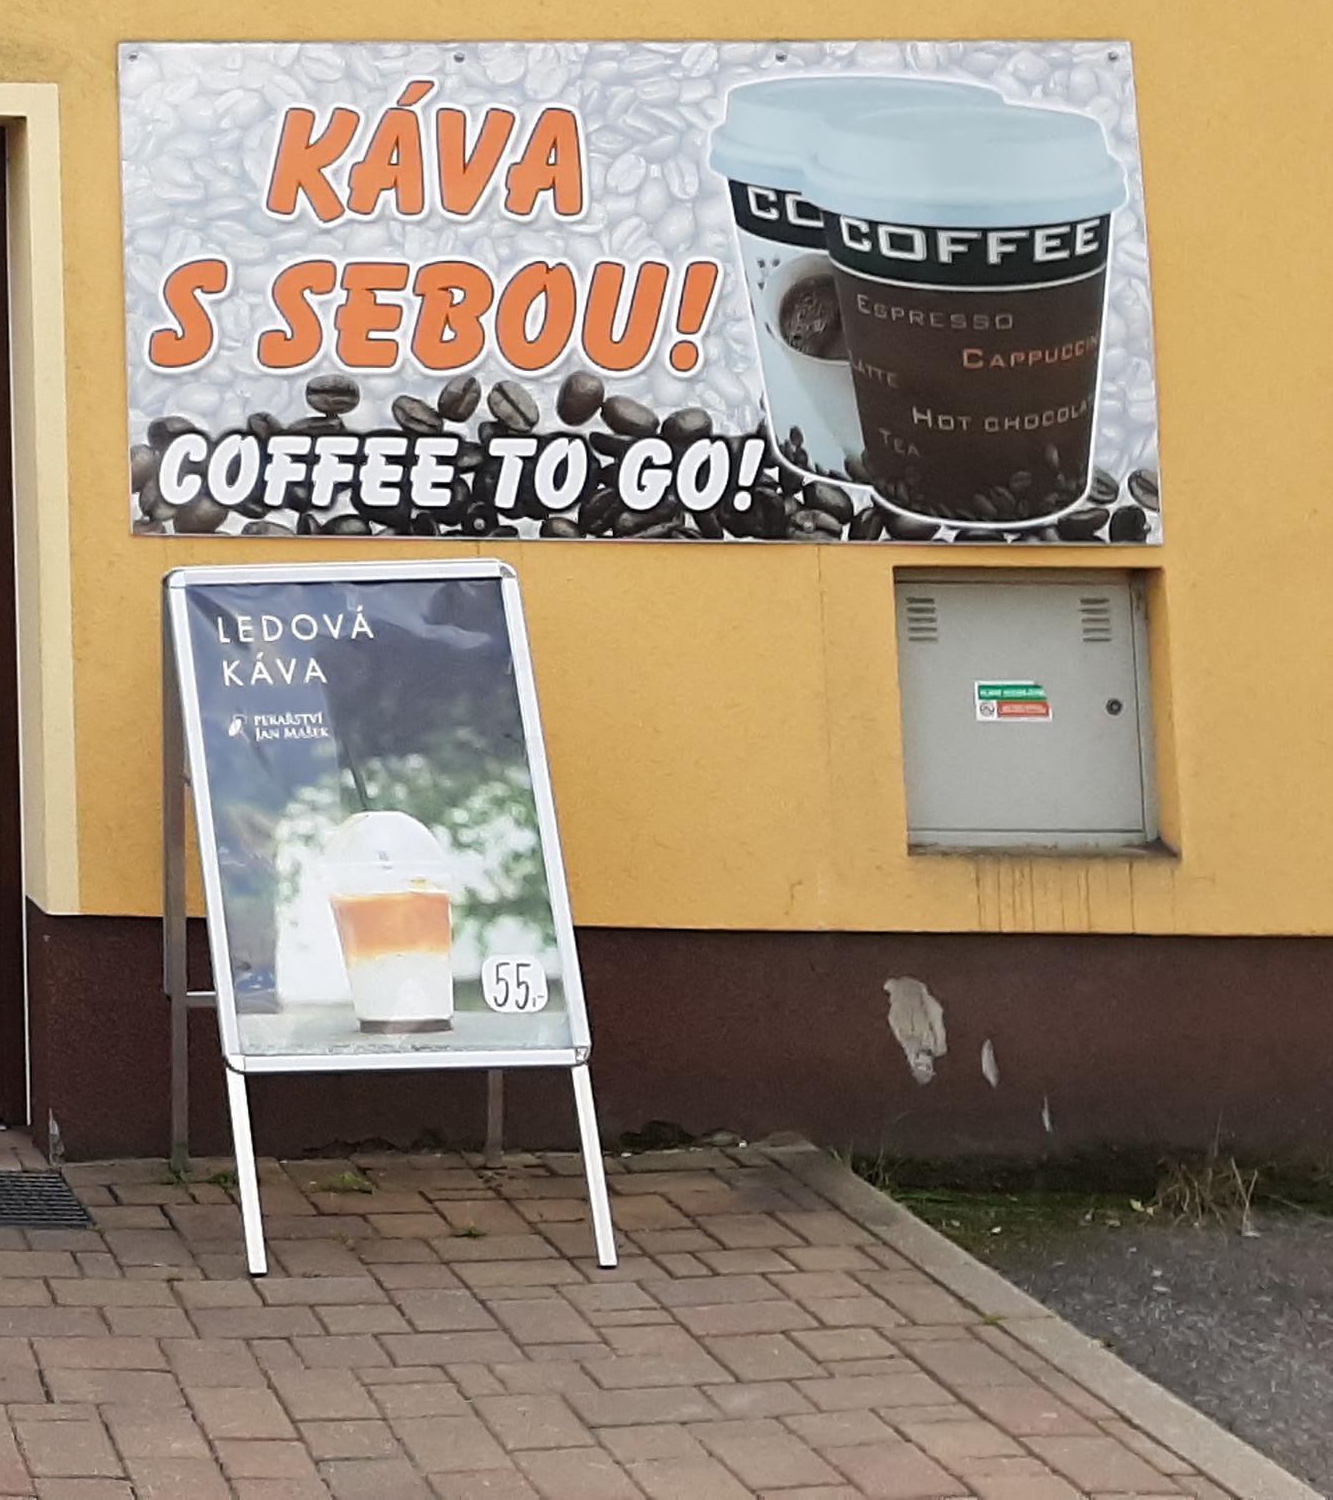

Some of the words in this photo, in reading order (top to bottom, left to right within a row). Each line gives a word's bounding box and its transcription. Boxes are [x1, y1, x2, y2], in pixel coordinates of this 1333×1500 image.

[265, 80, 584, 218] KÁVA
[839, 215, 1101, 265] COFFEE
[148, 259, 227, 368] S
[256, 259, 721, 371] SEBOU!
[159, 433, 459, 509] COFFEE
[486, 435, 589, 509] TO
[617, 435, 767, 509] GO!
[217, 604, 374, 644] LEDOVÁ
[222, 651, 328, 687] KÁVA
